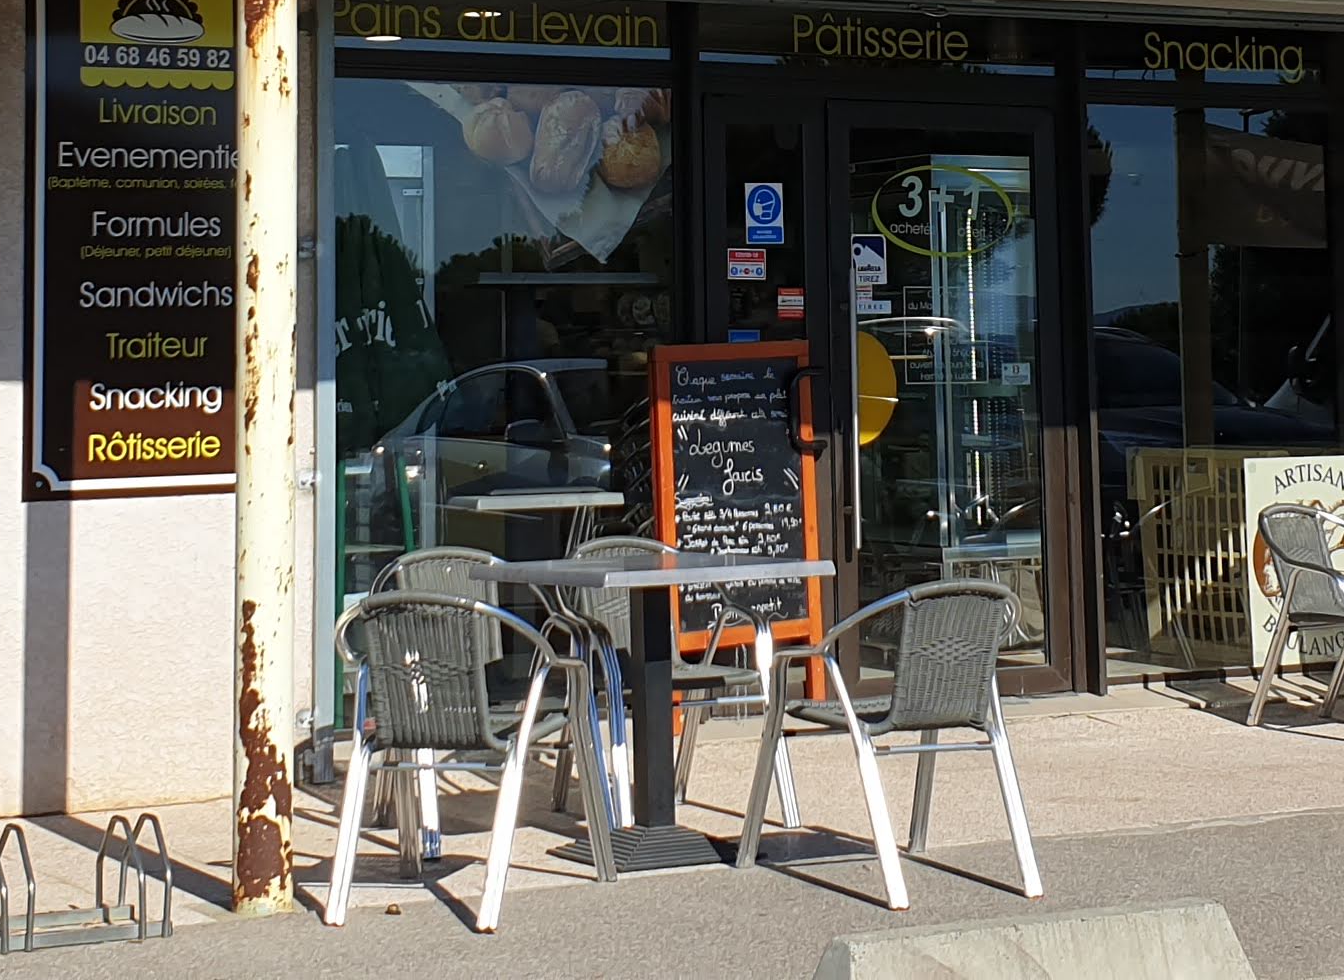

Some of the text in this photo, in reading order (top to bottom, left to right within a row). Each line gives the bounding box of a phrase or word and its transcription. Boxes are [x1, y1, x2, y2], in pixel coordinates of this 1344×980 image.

[456, 11, 516, 42] au
[532, 3, 659, 47] levain
[792, 13, 969, 62] Pâtisserie
[84, 45, 231, 68] 04 68 46 59 82
[1143, 31, 1305, 84] Snacking
[98, 97, 217, 126] Livraison
[58, 141, 240, 170] Evenementie
[91, 210, 222, 238] Formules
[145, 245, 172, 259] petit
[858, 275, 881, 283] TIREZ
[79, 281, 234, 308] Sandwichs
[105, 332, 208, 360] Traiteur
[89, 380, 223, 415] Snacking
[88, 430, 222, 462] Rôtisserie
